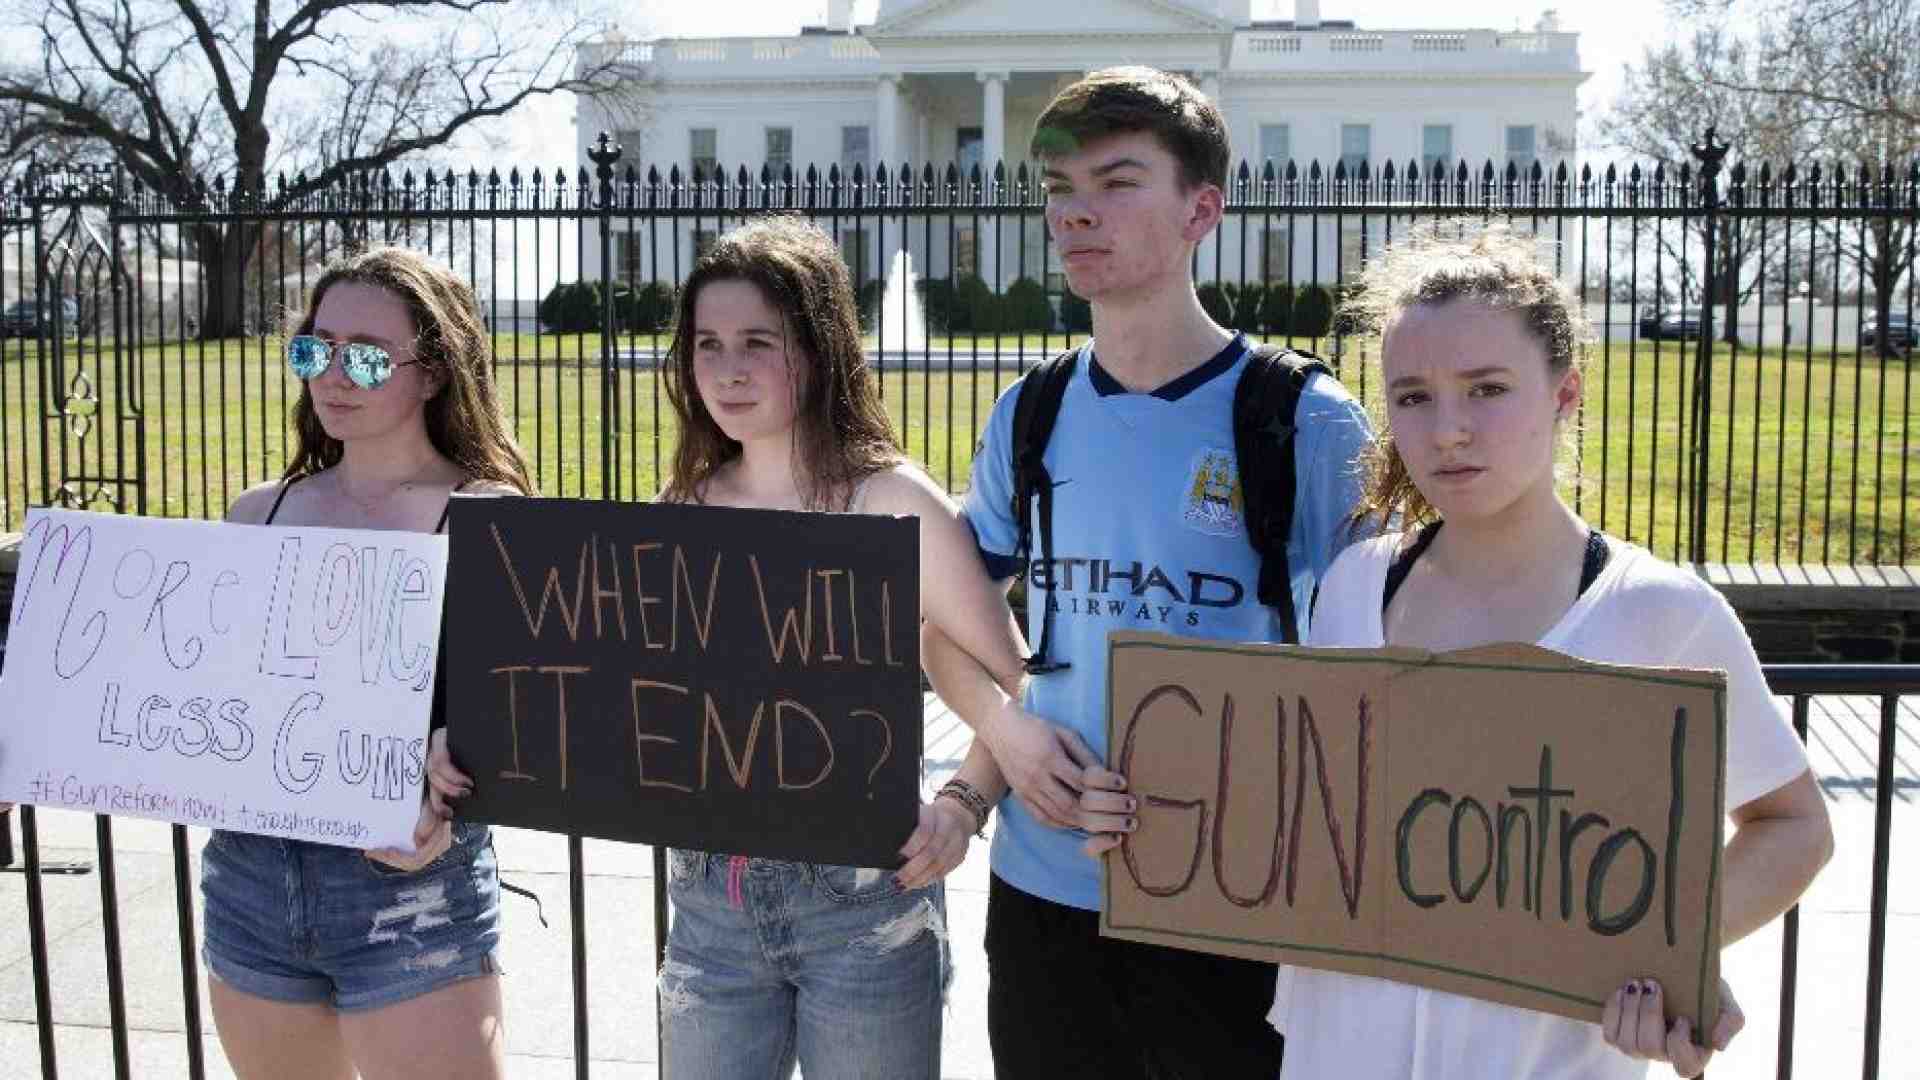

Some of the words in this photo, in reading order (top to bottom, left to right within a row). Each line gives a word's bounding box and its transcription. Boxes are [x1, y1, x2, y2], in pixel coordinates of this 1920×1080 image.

[490, 521, 722, 653] WHEN
[748, 553, 904, 666] WILL
[1031, 558, 1244, 607] ETIHAD
[99, 682, 254, 761] Less
[489, 664, 592, 792] IT
[631, 678, 893, 800] END?
[1121, 683, 1373, 921] GUN
[1395, 704, 1688, 947] control
